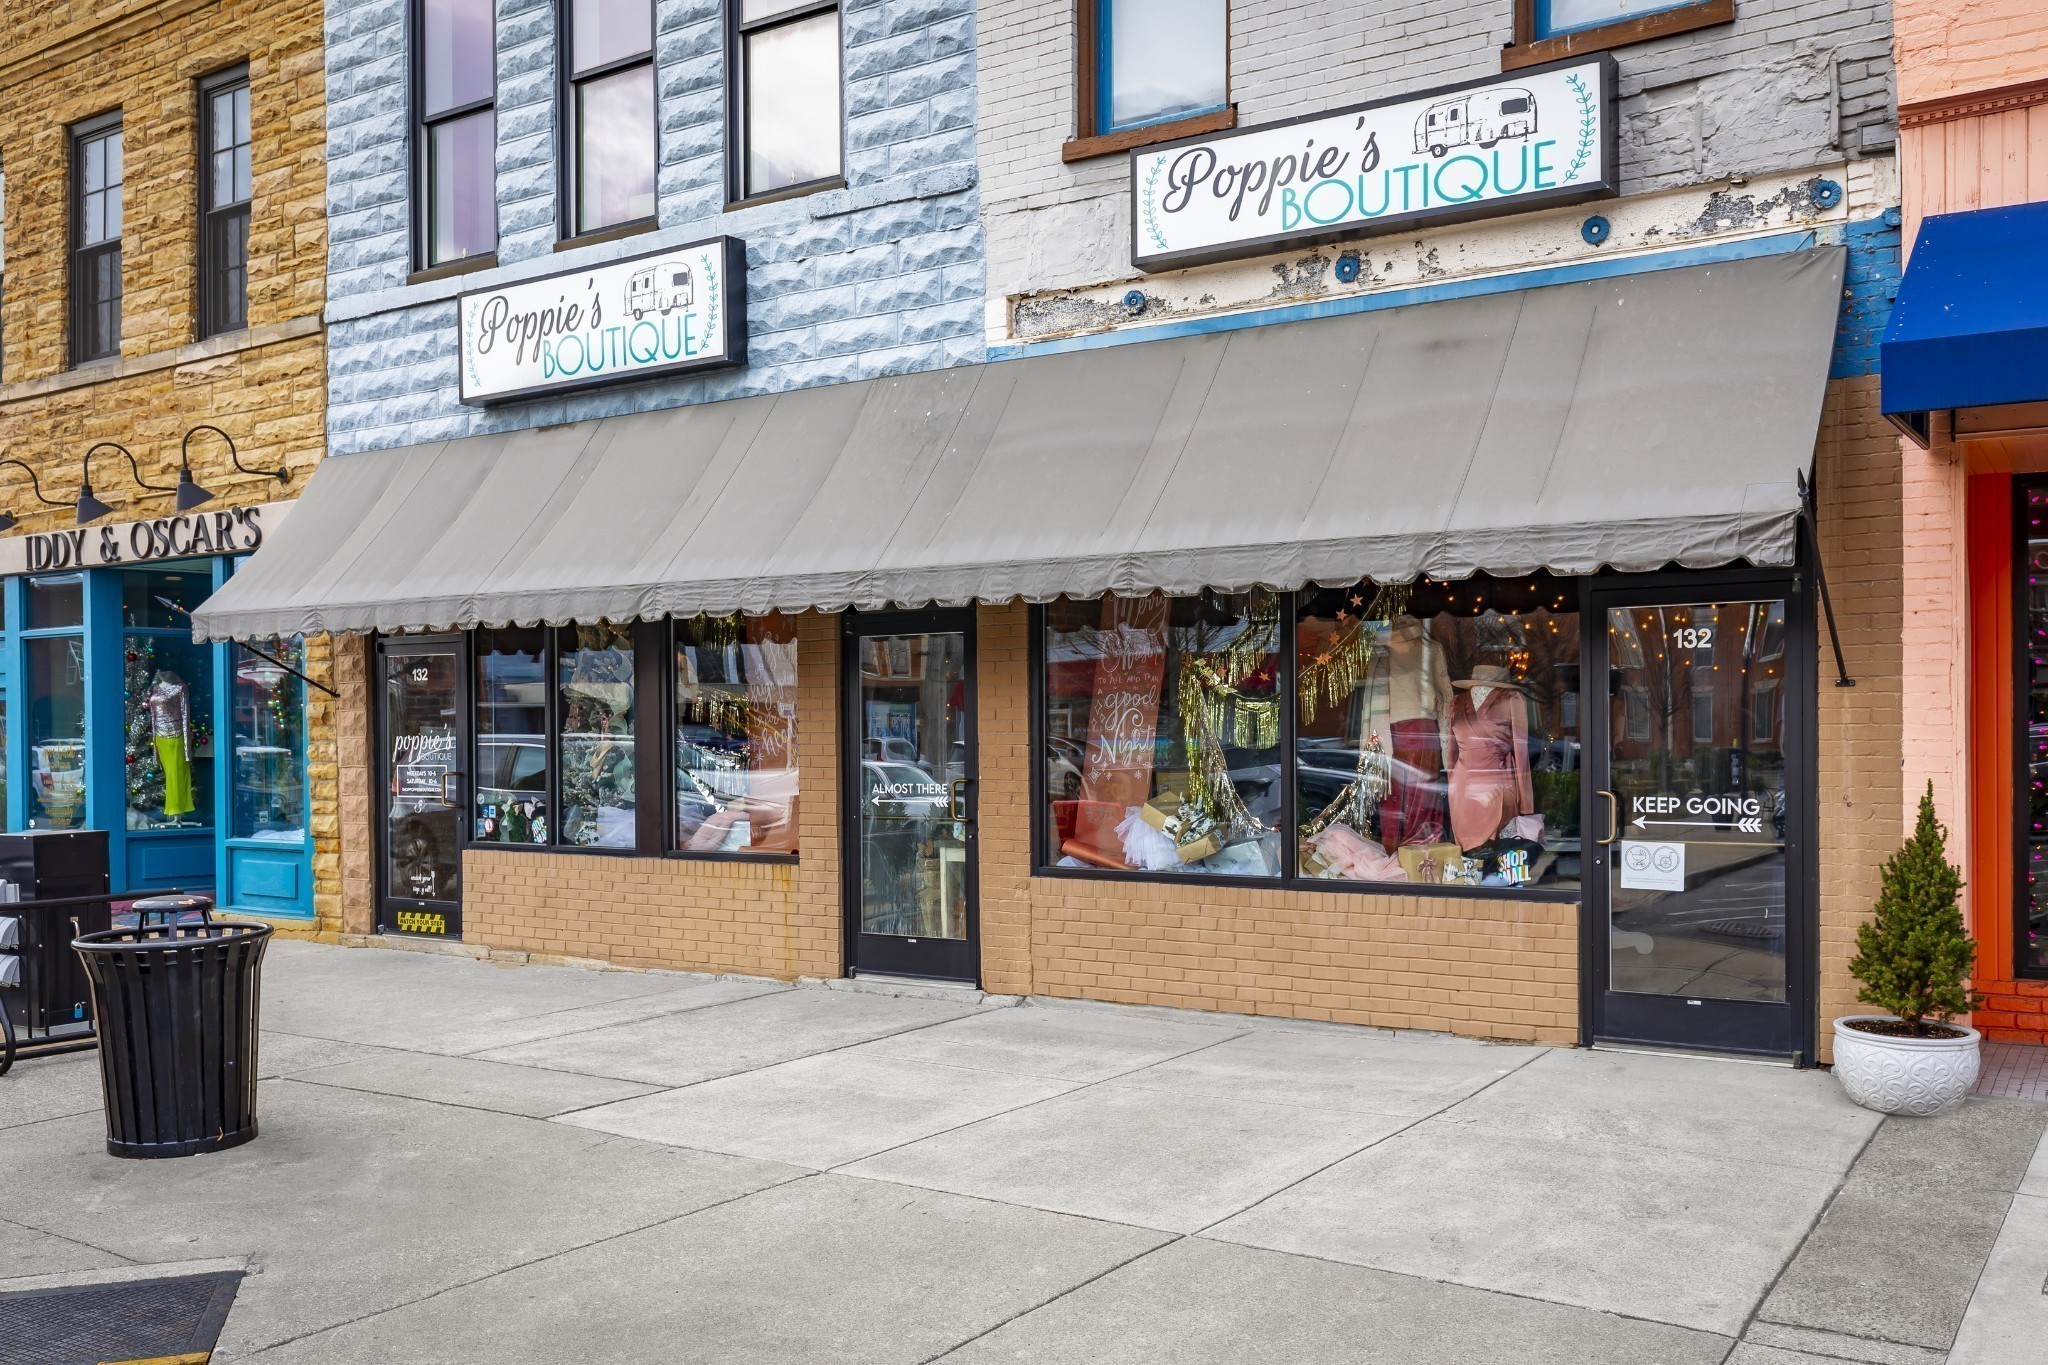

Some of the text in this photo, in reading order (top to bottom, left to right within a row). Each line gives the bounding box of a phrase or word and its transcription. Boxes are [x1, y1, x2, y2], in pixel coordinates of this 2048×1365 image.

[1162, 116, 1380, 222] Poppie's
[1282, 140, 1557, 231] BOUTIQUE
[477, 277, 602, 366] Poppie's
[543, 312, 698, 379] BOUTIQUE
[25, 505, 263, 571] IDDY & OSCAR'S
[1673, 627, 1712, 649] 132
[412, 668, 428, 681] 132
[1098, 677, 1107, 685] TO
[1126, 675, 1141, 683] AND
[1104, 684, 1160, 731] good
[392, 722, 452, 763] poppie's
[421, 752, 452, 761] BOUTIQUE
[1091, 707, 1156, 768] Night
[872, 783, 948, 794] ALMOST THERE
[1633, 796, 1761, 815] KEEP GOING
